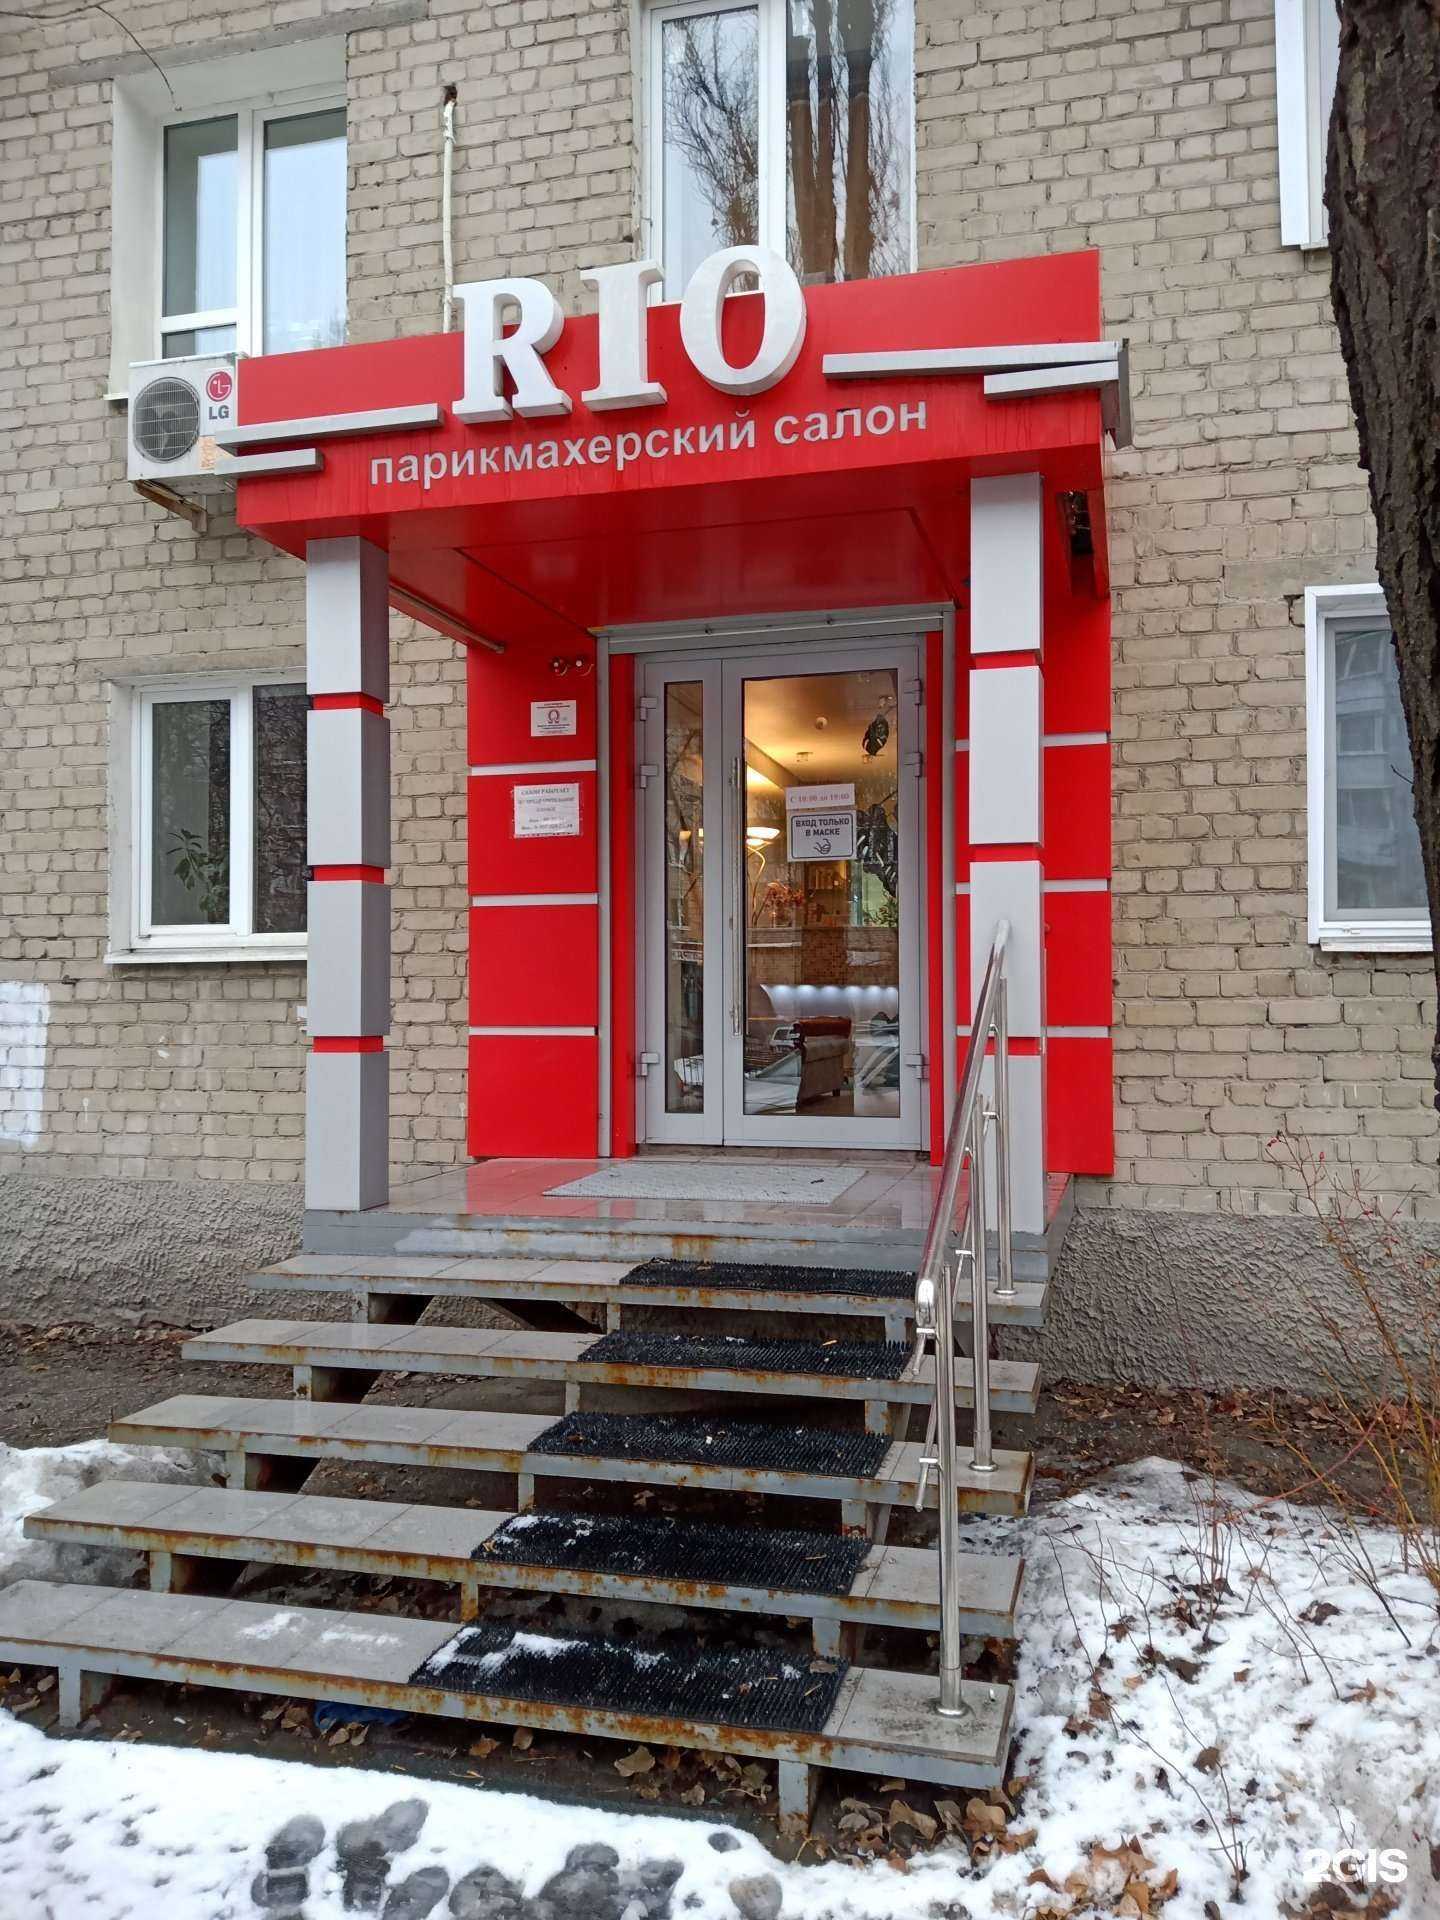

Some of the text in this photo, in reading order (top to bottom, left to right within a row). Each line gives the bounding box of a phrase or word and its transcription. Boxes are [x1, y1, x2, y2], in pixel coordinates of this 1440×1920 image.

[452, 244, 807, 424] RIO
[209, 405, 229, 420] LG
[370, 401, 927, 489] парикмахерский салон
[795, 817, 850, 828] ВХОД ТОЛЬКО
[805, 827, 841, 837] В МАСКЕ
